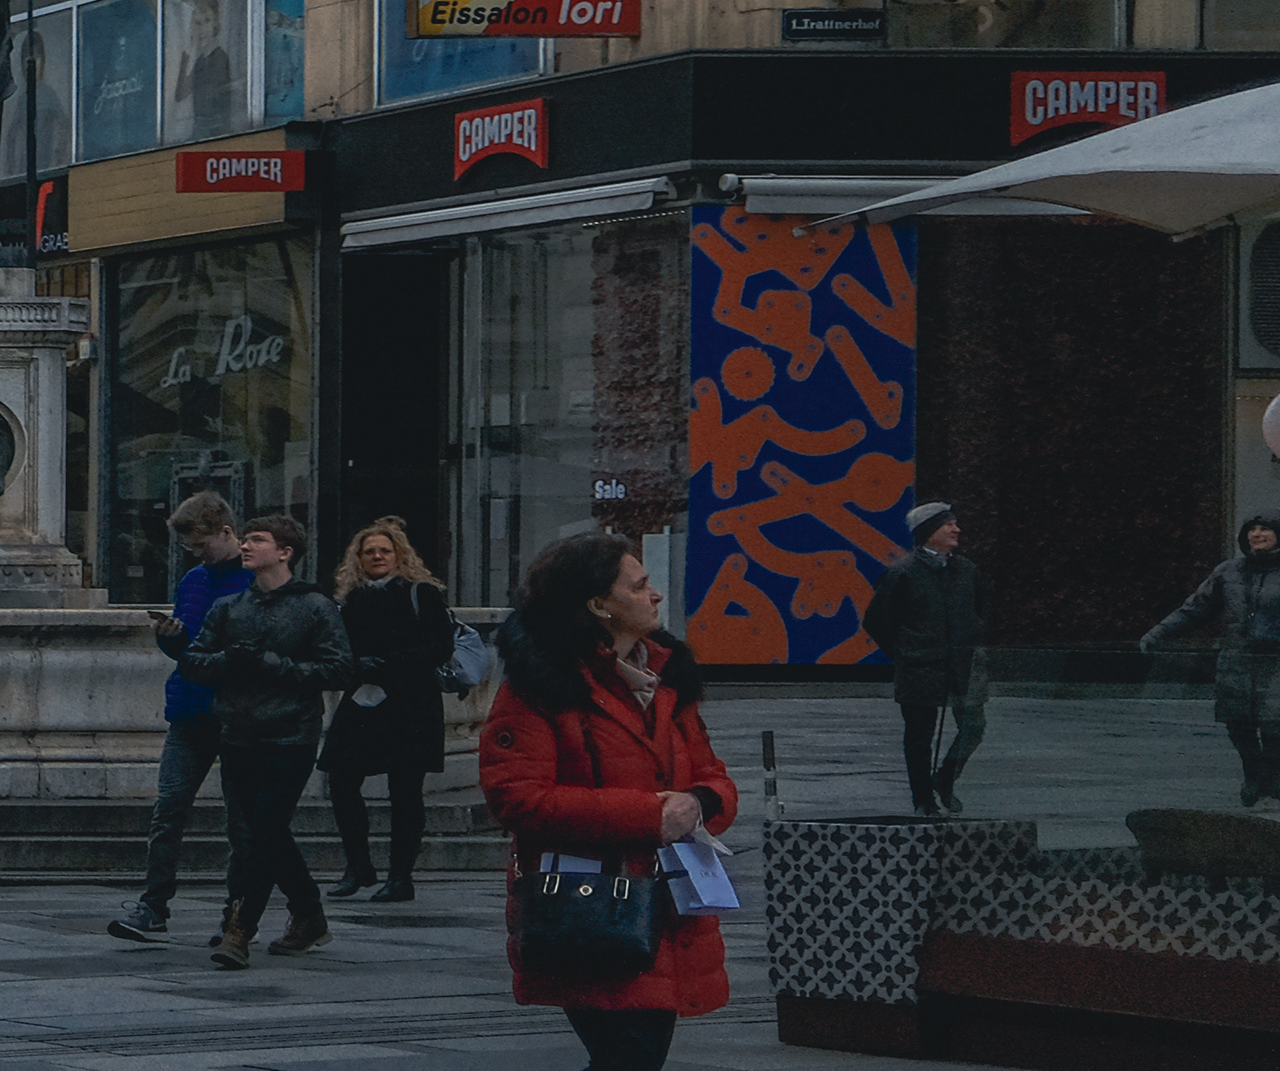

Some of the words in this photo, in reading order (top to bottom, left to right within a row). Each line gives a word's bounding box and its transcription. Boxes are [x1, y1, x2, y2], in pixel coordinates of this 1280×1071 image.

[430, 0, 548, 25] Eissalon
[1024, 79, 1159, 125] CAMPER
[458, 108, 538, 162] CAMPER
[205, 157, 282, 184] CAMPER
[593, 479, 627, 499] Sale
